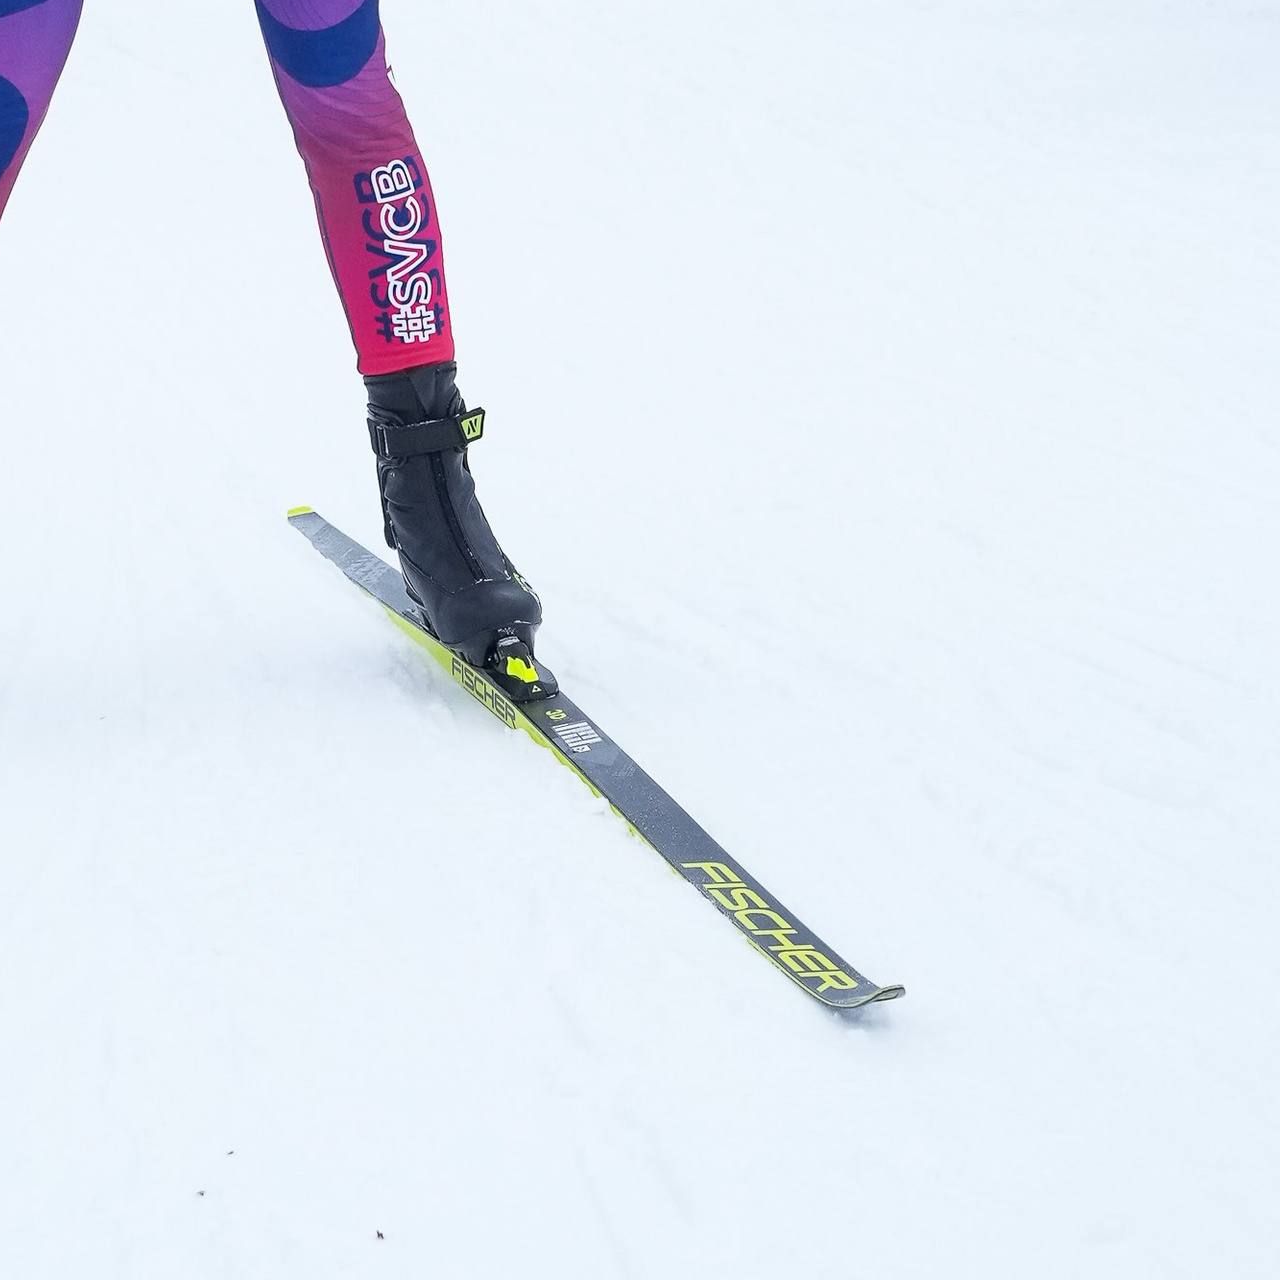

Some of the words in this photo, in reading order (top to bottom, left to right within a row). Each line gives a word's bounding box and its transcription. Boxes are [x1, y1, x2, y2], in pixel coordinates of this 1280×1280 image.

[371, 159, 436, 344] #SVCB
[451, 657, 517, 729] FISCHER
[682, 862, 857, 994] FISCHER
